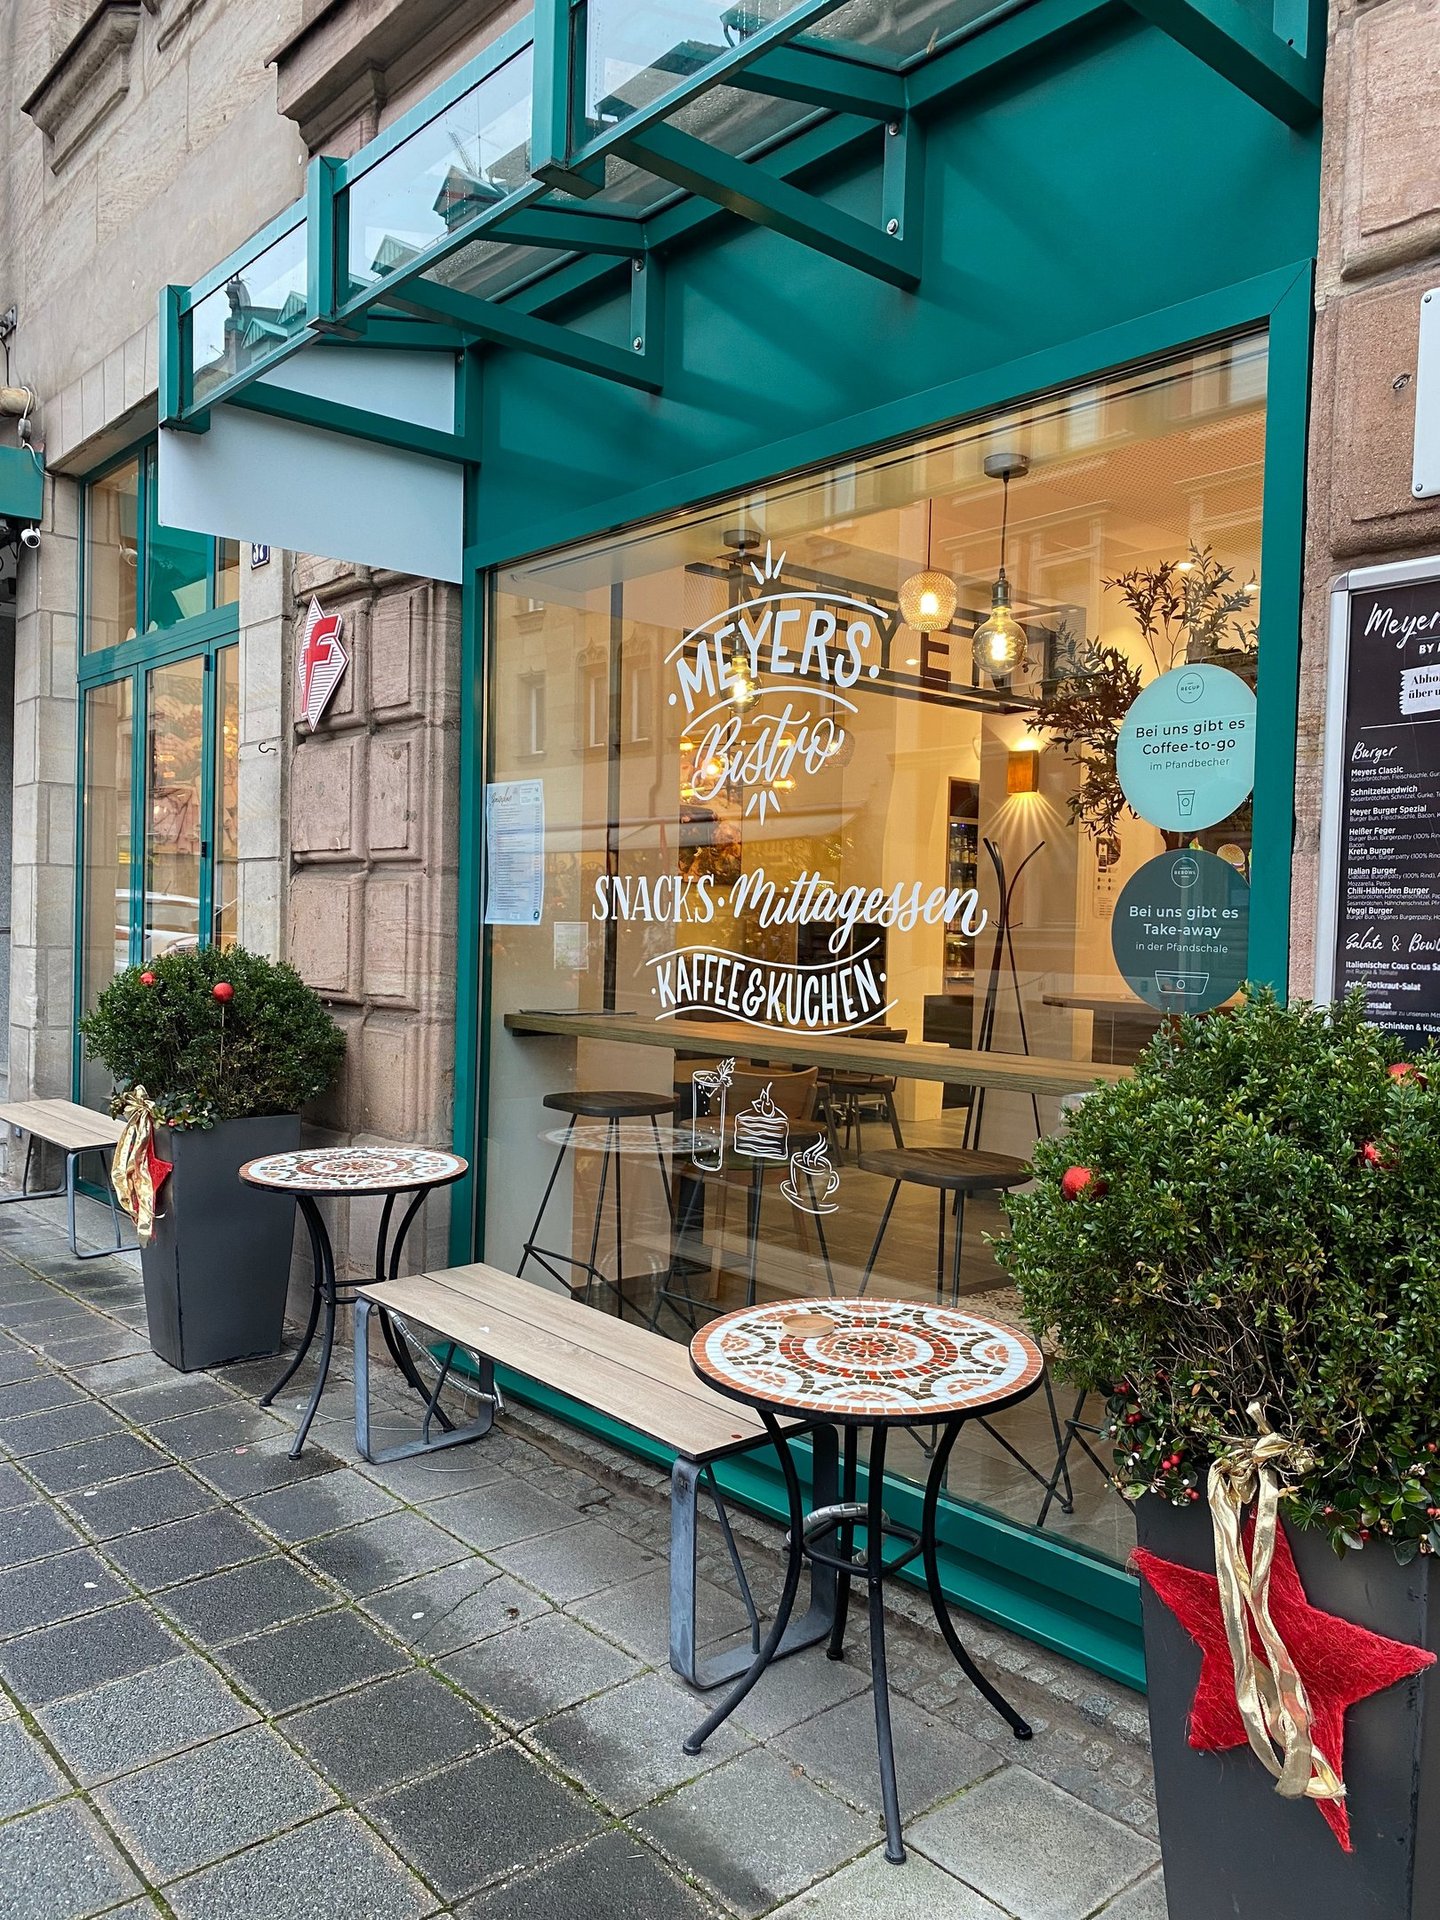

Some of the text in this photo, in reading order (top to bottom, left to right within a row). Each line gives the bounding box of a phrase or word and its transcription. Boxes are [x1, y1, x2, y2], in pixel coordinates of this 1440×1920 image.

[1418, 643, 1434, 654] BY
[676, 609, 872, 714] MEYERS
[1411, 674, 1440, 685] Abho
[1408, 689, 1433, 699] über
[1136, 720, 1245, 738] Bei uns gibt es
[692, 703, 845, 801] Bistro
[1143, 739, 1236, 755] Coffee-to-go
[1351, 741, 1398, 764] Burger
[1149, 758, 1230, 770] im Pfandbecher
[1351, 766, 1404, 777] Meyers Classic
[1350, 785, 1418, 796] Schnitzelsandwich
[1349, 804, 1427, 816] Meyer Burger Spezial
[1349, 826, 1396, 835] Heißer Feger
[1369, 847, 1395, 855] Burger
[1371, 866, 1397, 875] Burger
[1403, 887, 1430, 895] Burger
[591, 868, 988, 954] SNACKS Mittagessen
[1129, 905, 1239, 920] Bei uns gibt es
[1346, 906, 1394, 915] Veggi Burger
[1143, 923, 1221, 939] Take-away
[1345, 926, 1383, 950] Salate
[1391, 934, 1401, 951] &
[1135, 942, 1228, 953] in der Pfandschale
[1345, 961, 1390, 969] Italienischer
[1391, 962, 1409, 970] Cous
[1411, 962, 1431, 971] Cous
[1344, 980, 1421, 991] Apf-Rotkraut-Salat
[1380, 1021, 1414, 1030] Schinken
[1415, 1023, 1421, 1031] &
